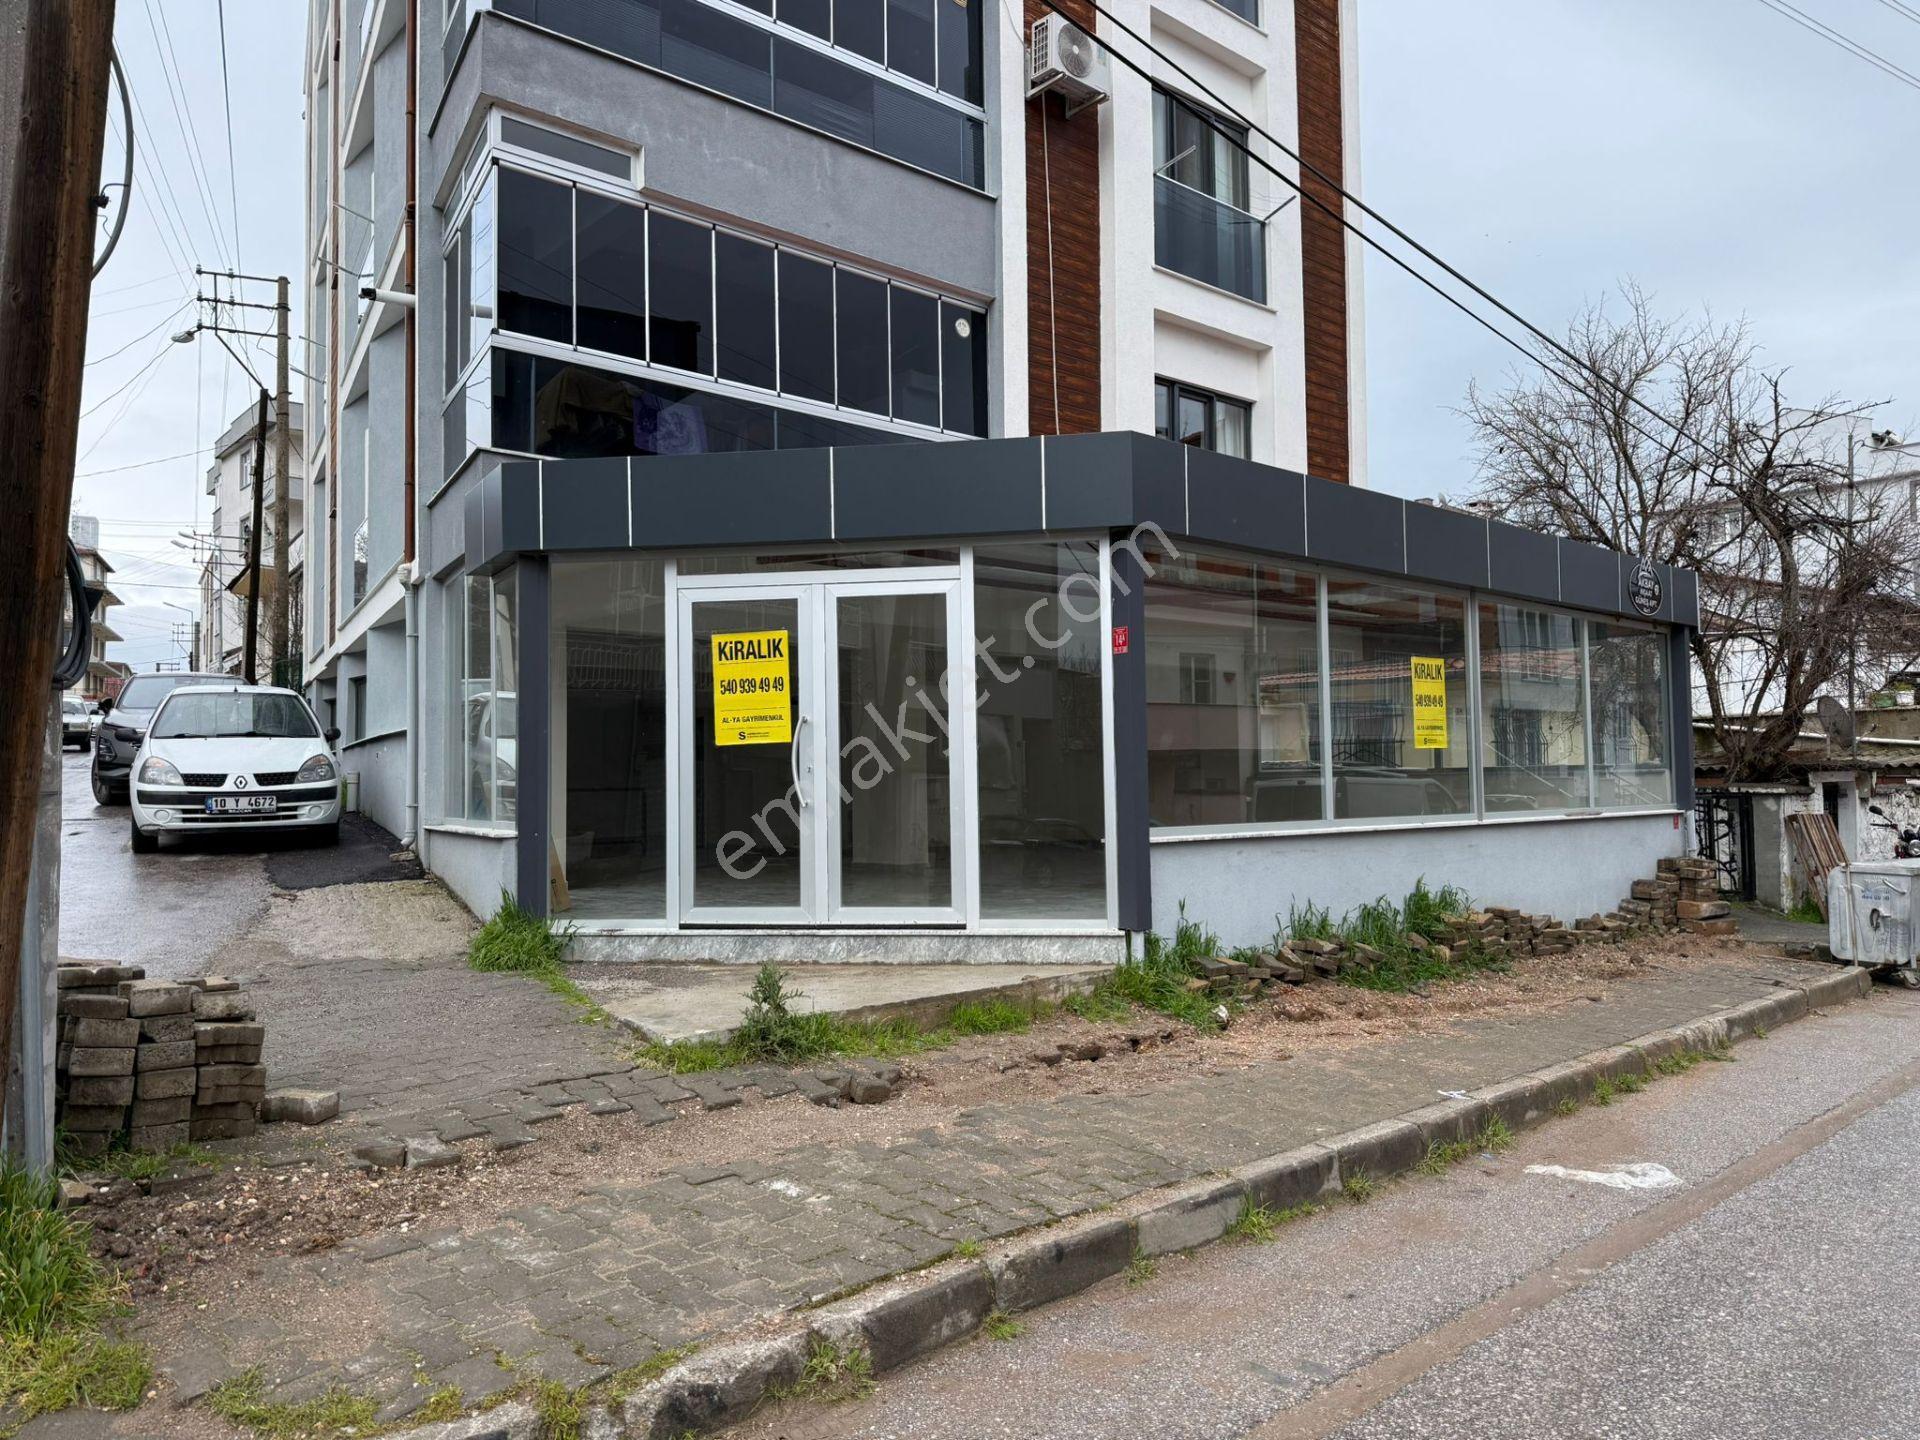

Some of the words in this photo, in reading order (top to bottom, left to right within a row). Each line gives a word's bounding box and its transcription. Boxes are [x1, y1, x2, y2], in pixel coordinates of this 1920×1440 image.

[720, 680, 737, 695] 540
[739, 678, 756, 694] 939
[758, 677, 771, 693] 49
[772, 676, 784, 692] 49
[213, 798, 227, 809] 10
[233, 797, 240, 808] Y
[247, 796, 275, 807] 4672
